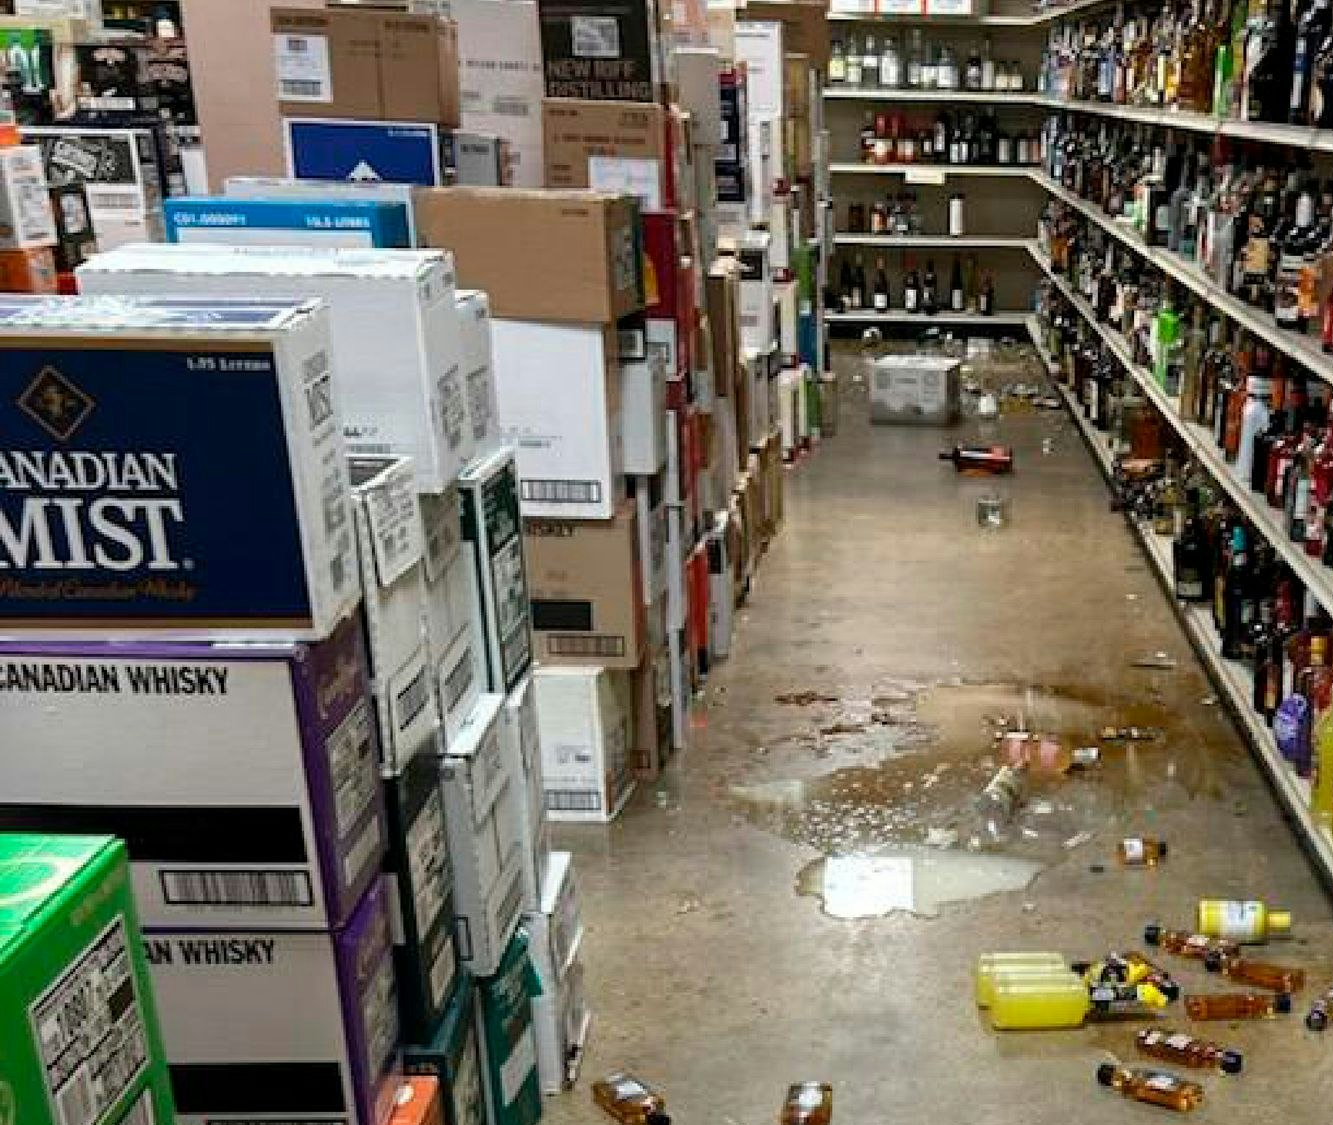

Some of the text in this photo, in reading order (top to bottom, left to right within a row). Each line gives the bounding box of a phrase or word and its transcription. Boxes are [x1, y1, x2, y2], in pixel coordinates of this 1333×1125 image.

[0, 664, 228, 695] ANADIAN WHISKY
[178, 939, 274, 965] WHISKY
